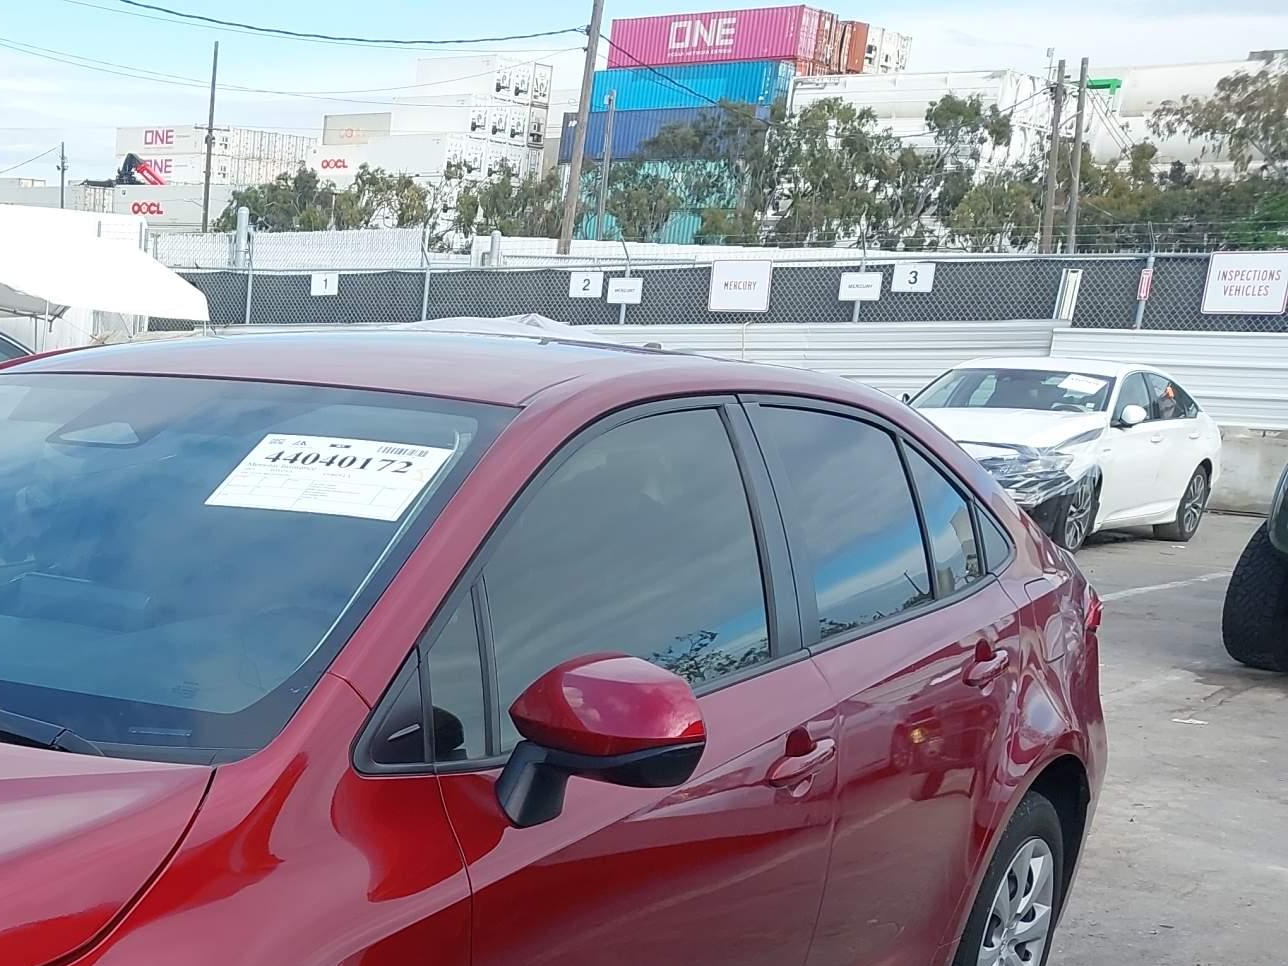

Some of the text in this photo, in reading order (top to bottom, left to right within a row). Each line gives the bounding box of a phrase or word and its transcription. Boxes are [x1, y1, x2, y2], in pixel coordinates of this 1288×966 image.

[668, 17, 736, 49] ONE
[144, 129, 174, 145] ONE
[321, 158, 349, 169] OOCL
[131, 202, 164, 215] OOCL
[907, 270, 919, 285] 3
[1217, 269, 1282, 282] INSPECTIONS
[322, 277, 328, 290] 1
[581, 278, 591, 291] 2
[723, 280, 757, 291] MERCURY
[1222, 285, 1270, 297] VEHICLES
[265, 450, 413, 474] 44040172
